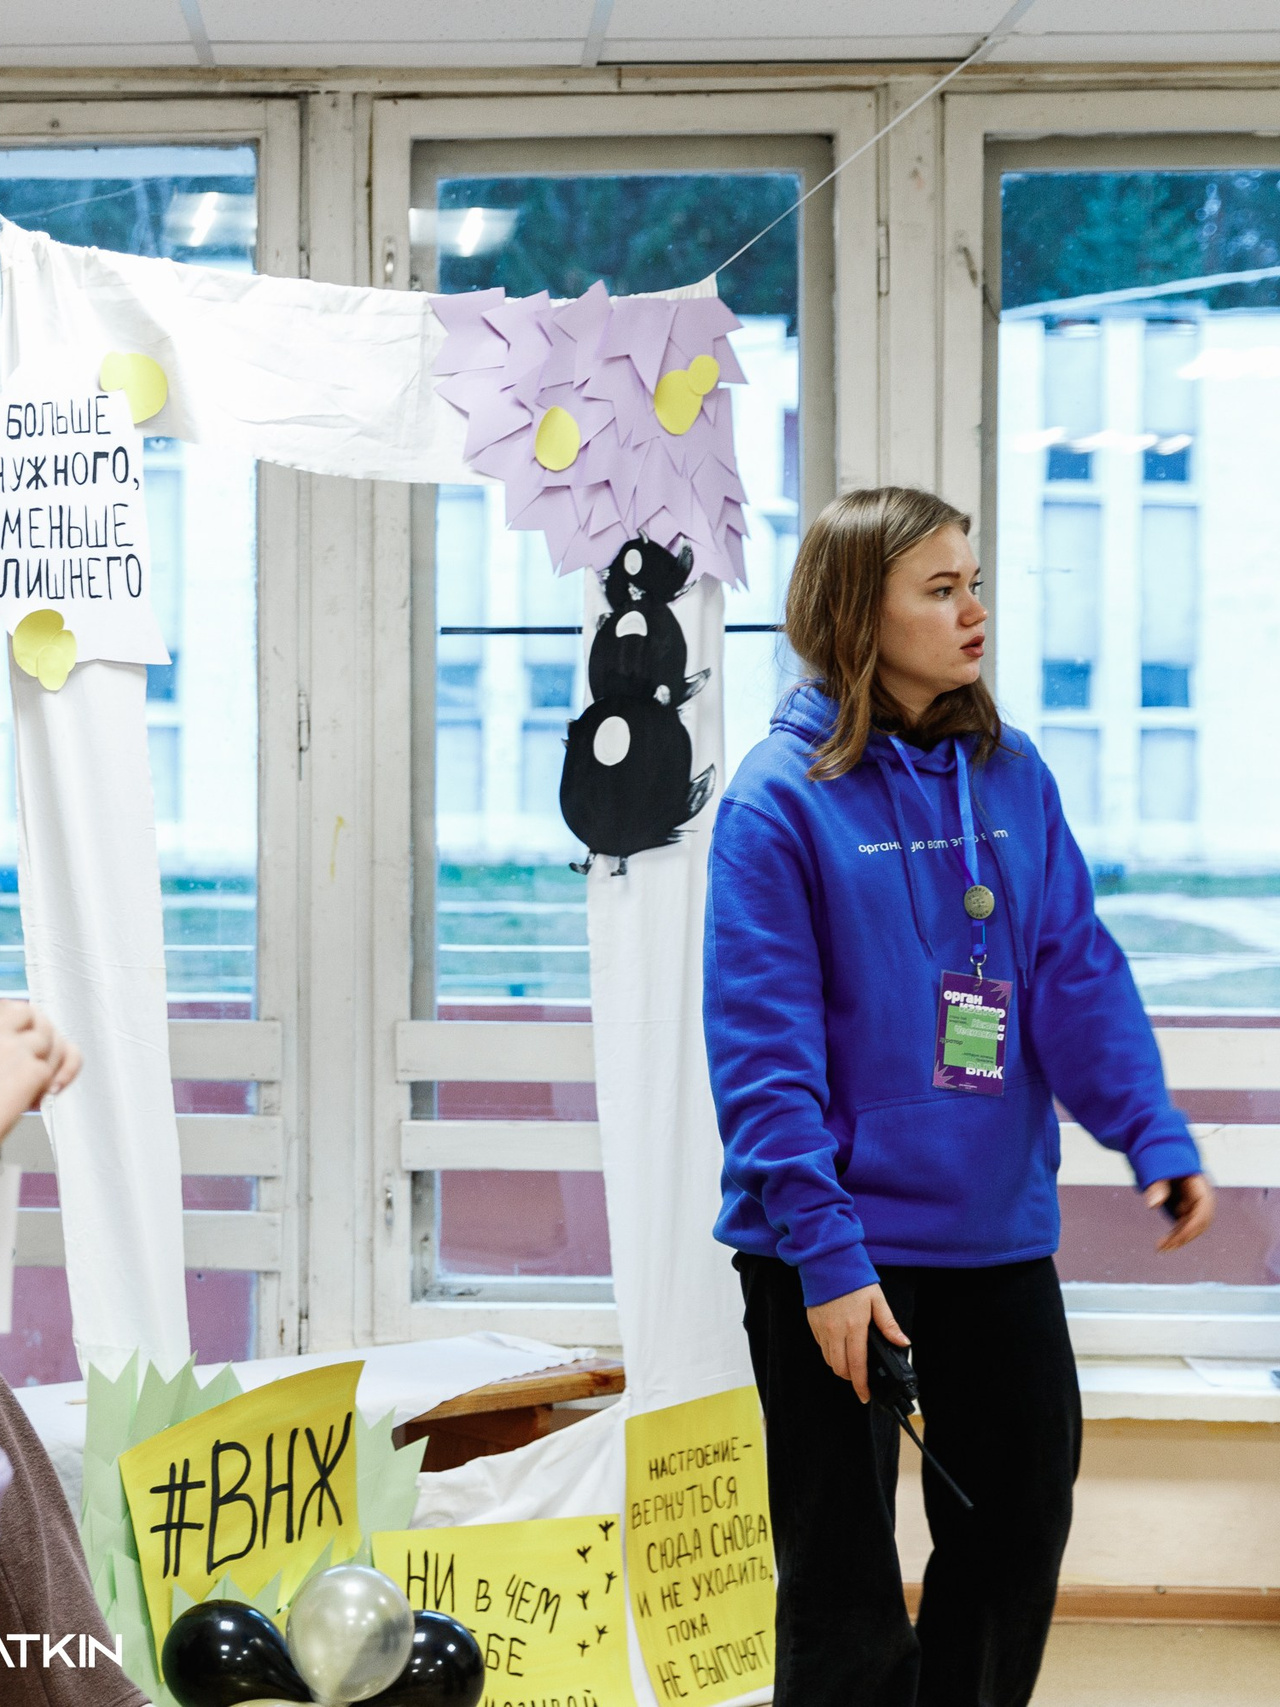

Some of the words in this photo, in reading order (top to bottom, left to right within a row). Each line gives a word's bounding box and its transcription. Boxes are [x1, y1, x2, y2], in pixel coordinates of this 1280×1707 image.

[6, 395, 111, 440] БОЛЬШЕ
[1, 503, 134, 550] МЕНЬШЕ
[943, 990, 984, 1005] орган
[150, 1411, 353, 1579] #ВНЖ
[631, 1475, 739, 1529] ВЕРНУТЬСЯ
[646, 1528, 704, 1574] СЮДА
[710, 1513, 768, 1558] СНОВА
[406, 1549, 455, 1613] НИ
[505, 1573, 561, 1634] ЧЕМ
[637, 1591, 652, 1618] И
[660, 1581, 683, 1613] НЕ
[666, 1612, 712, 1646] ПОКА
[656, 1660, 688, 1700] НЕ
[689, 1630, 771, 1690] ВЫГОНЯТ
